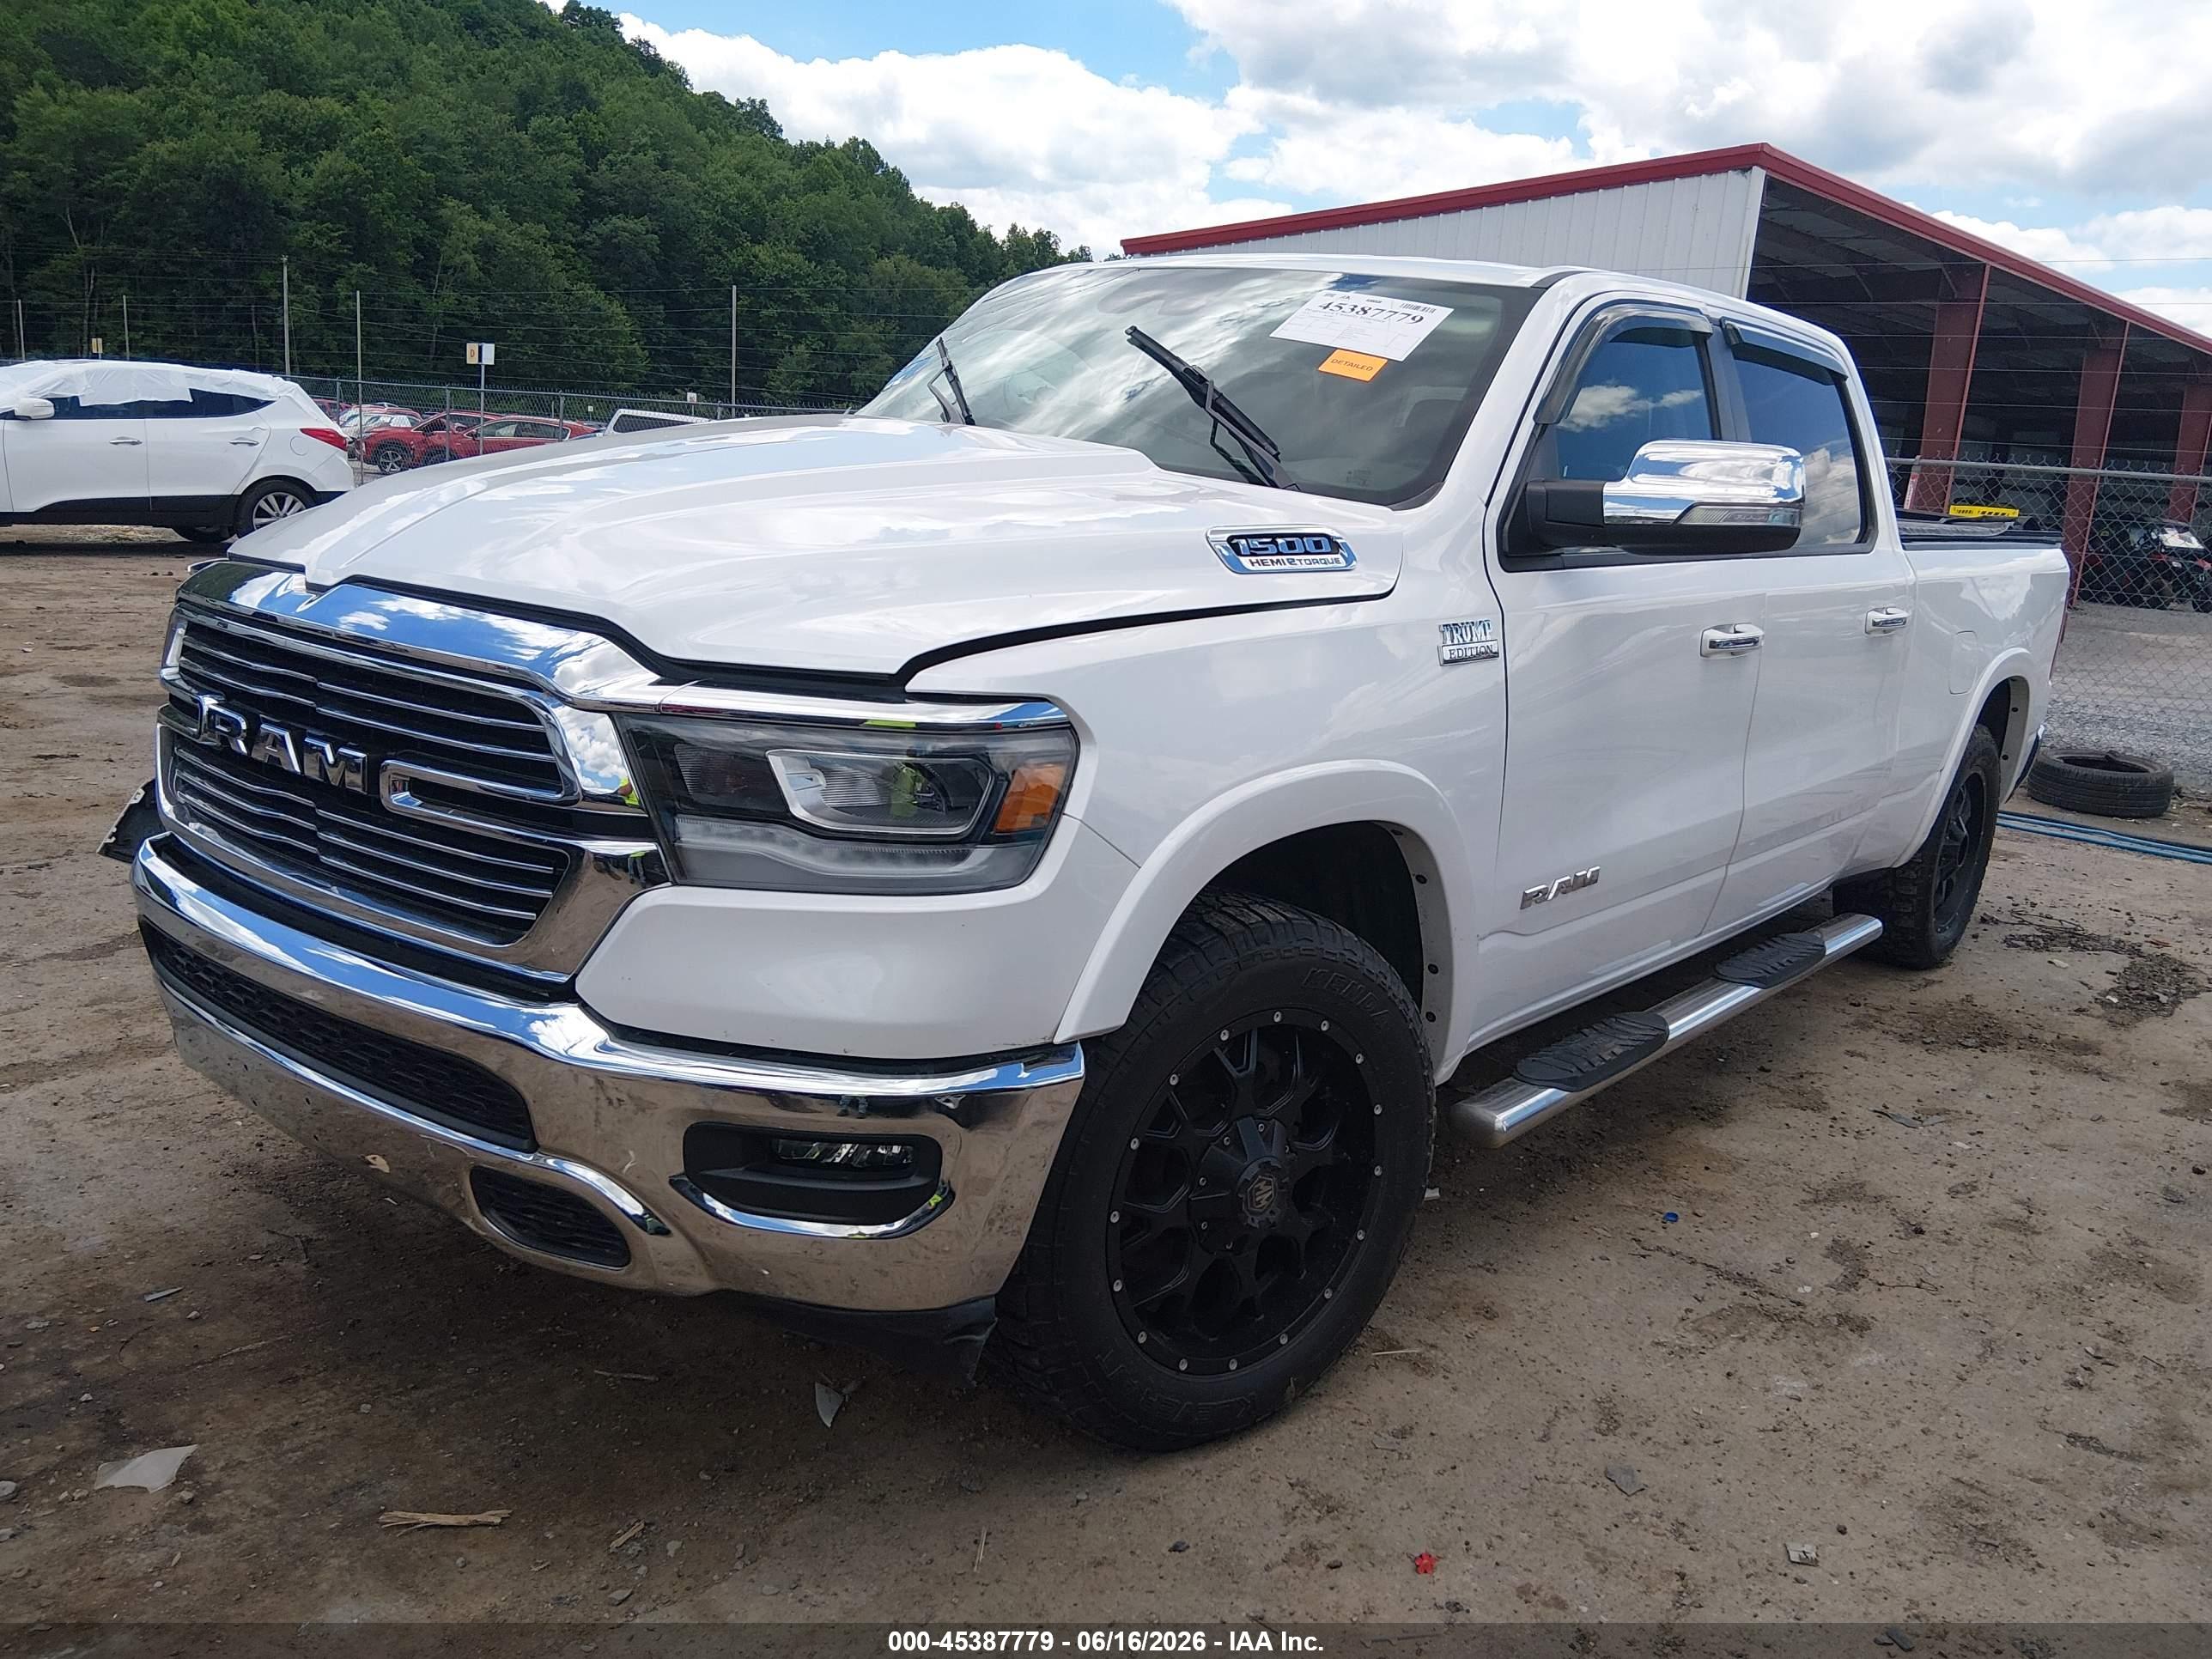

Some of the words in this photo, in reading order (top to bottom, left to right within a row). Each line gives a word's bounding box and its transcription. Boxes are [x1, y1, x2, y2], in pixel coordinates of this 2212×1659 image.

[1318, 301, 1425, 325] 45387779
[1330, 358, 1374, 372] DETAILED
[1231, 536, 1333, 556] 1500
[1249, 558, 1285, 568] HEMI
[1442, 619, 1493, 645] TRUMP
[1449, 644, 1494, 659] EDITION
[203, 700, 368, 795] RAM
[1519, 865, 1601, 910] RAM
[1300, 967, 1391, 1028] KENDA
